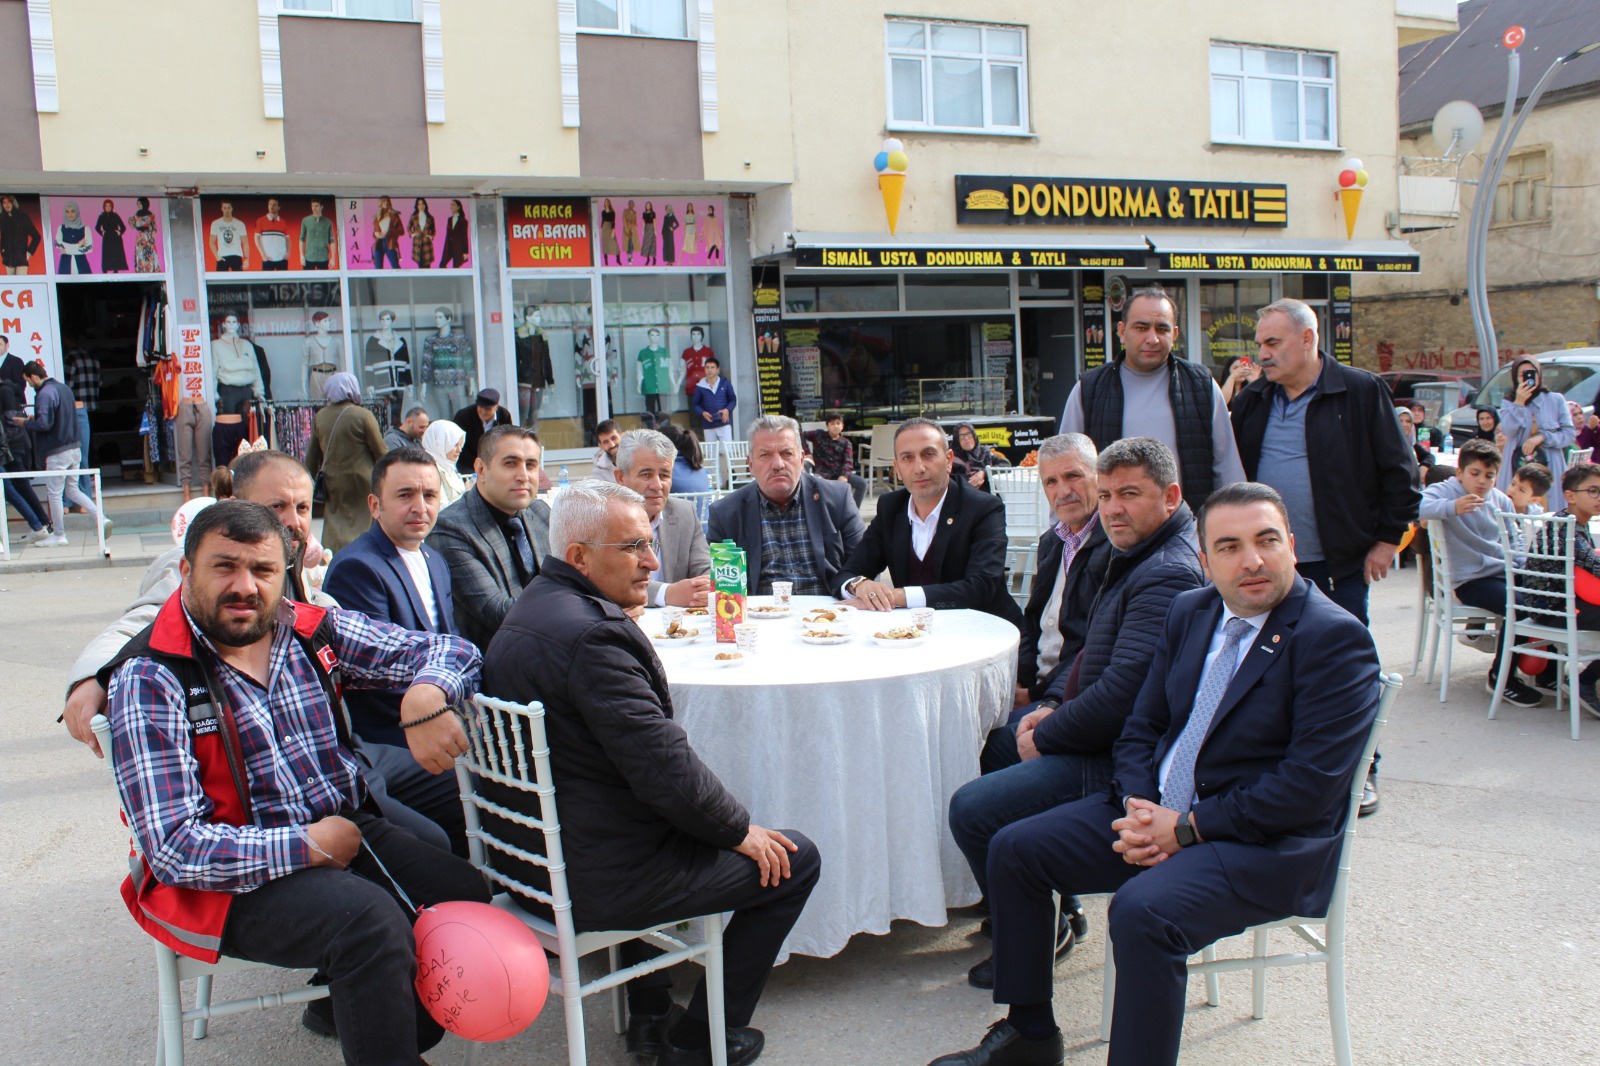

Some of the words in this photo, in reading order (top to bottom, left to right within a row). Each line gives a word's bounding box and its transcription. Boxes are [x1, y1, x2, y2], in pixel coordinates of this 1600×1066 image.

[1012, 183, 1162, 218] DONDURMA
[1168, 186, 1185, 218] &
[1189, 188, 1249, 219] TATLI
[524, 204, 572, 219] KARACA
[349, 200, 361, 264] BAYAN
[512, 224, 539, 240] BAY
[543, 224, 586, 240] BAYAN
[529, 242, 572, 260] GİYİM
[822, 248, 872, 266] İSMAİL
[880, 251, 917, 266] USTA
[926, 251, 1003, 266] DONDURMA
[1012, 251, 1021, 265] &
[1031, 252, 1066, 266] TATLI
[1170, 252, 1209, 269] İSMAİL
[1216, 256, 1245, 269] USTA
[1251, 257, 1312, 270] DONDURMA
[1319, 257, 1327, 270] &
[1334, 258, 1363, 270] TATLI
